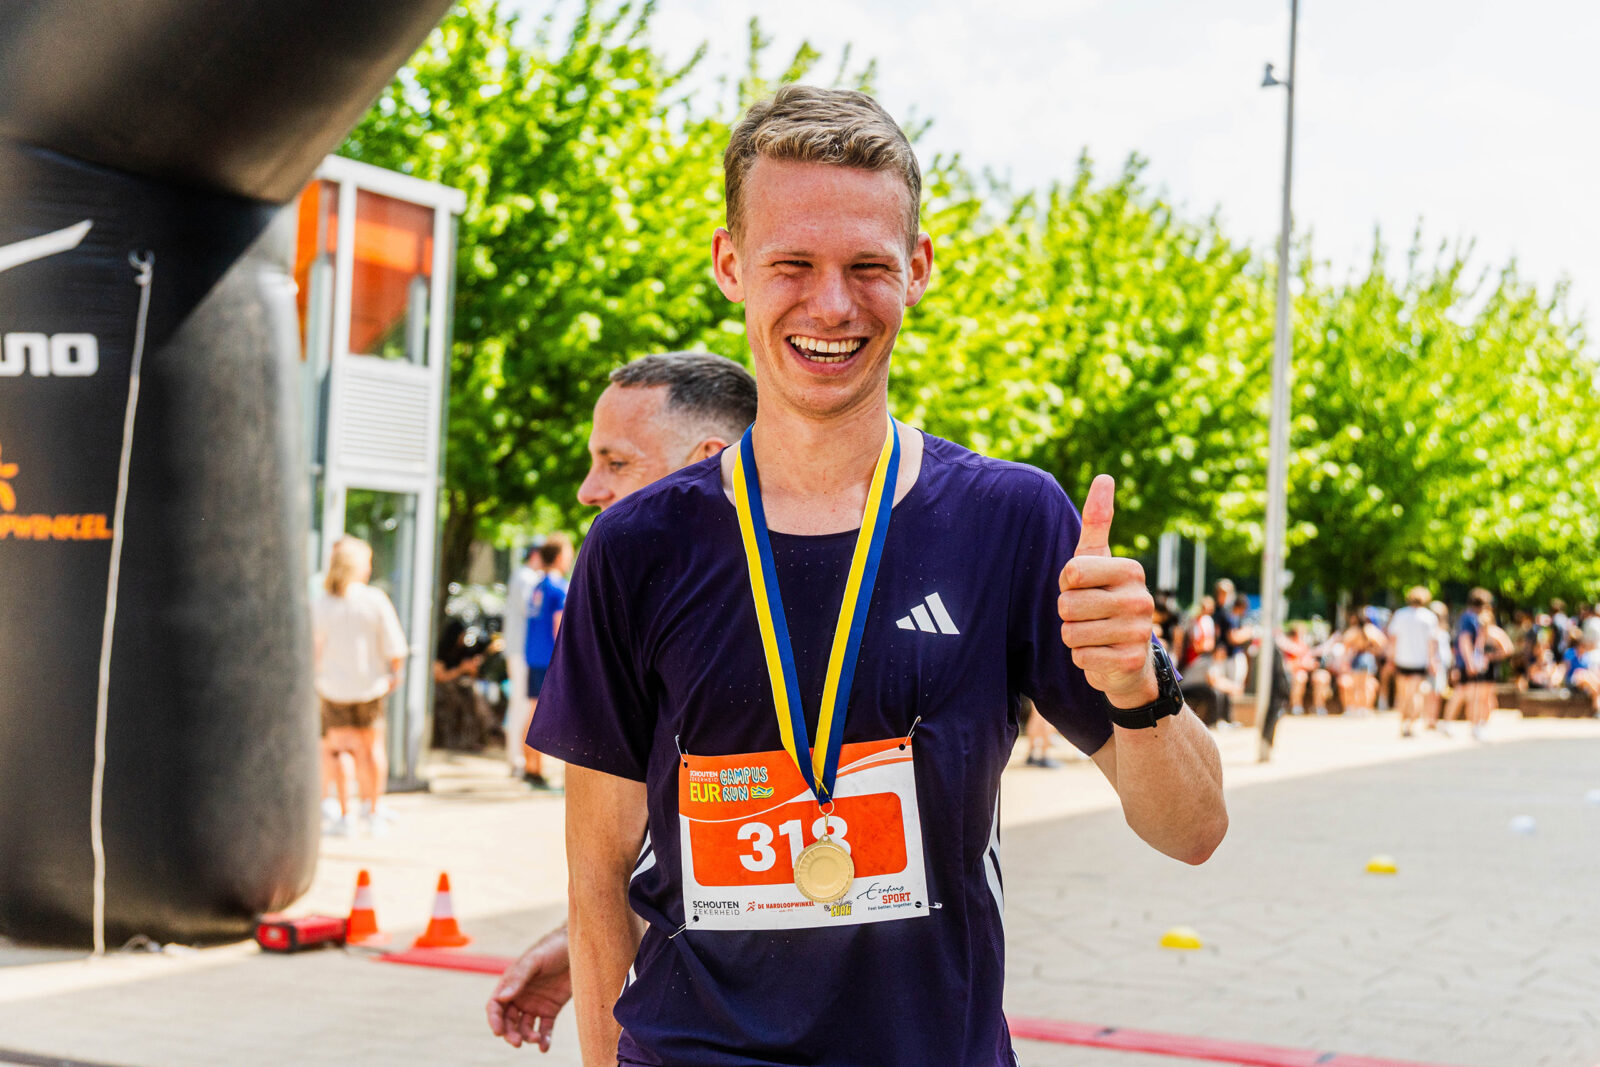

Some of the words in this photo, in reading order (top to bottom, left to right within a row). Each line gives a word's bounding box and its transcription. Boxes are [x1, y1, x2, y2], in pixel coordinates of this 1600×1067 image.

[690, 770, 718, 778] SCHOUTEN
[720, 766, 768, 786] CAMPUS
[690, 782, 722, 802] EUR
[722, 785, 749, 802] RUN
[882, 892, 911, 905] SPORT
[692, 900, 740, 910] SCHOUTEN
[765, 900, 816, 909] HARDLOOPWINKEL
[693, 908, 740, 916] ZEKERHEID
